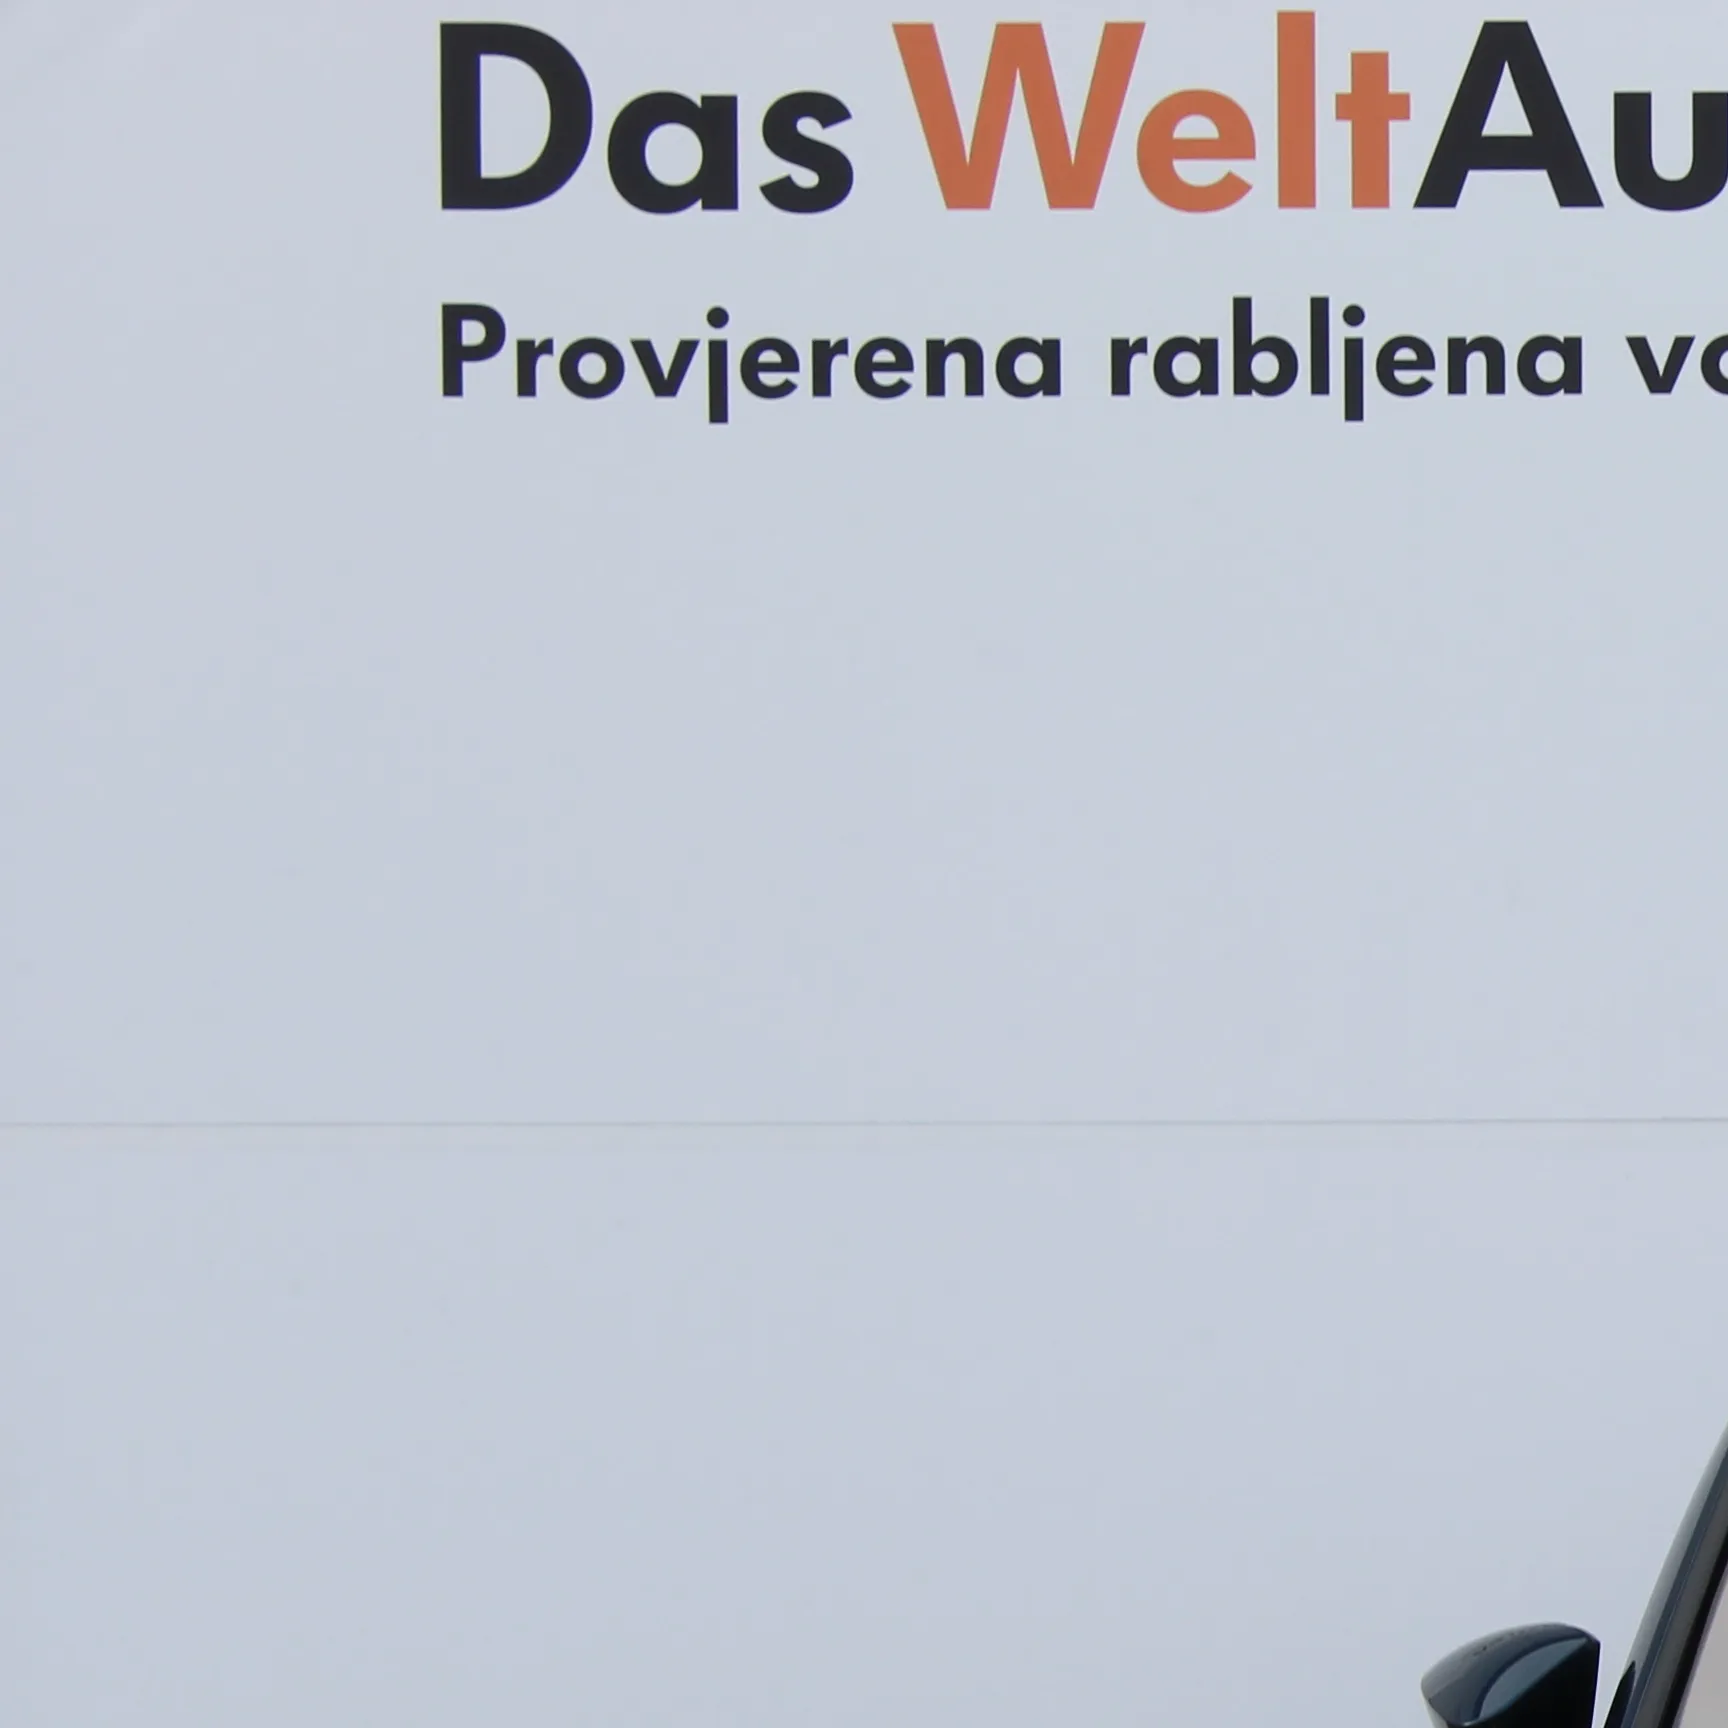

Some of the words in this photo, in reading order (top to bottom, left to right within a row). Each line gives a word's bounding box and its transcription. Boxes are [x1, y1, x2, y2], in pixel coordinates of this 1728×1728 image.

[440, 21, 854, 215] Das
[441, 303, 1062, 424] Provjerena
[1110, 296, 1583, 422] rabljena
